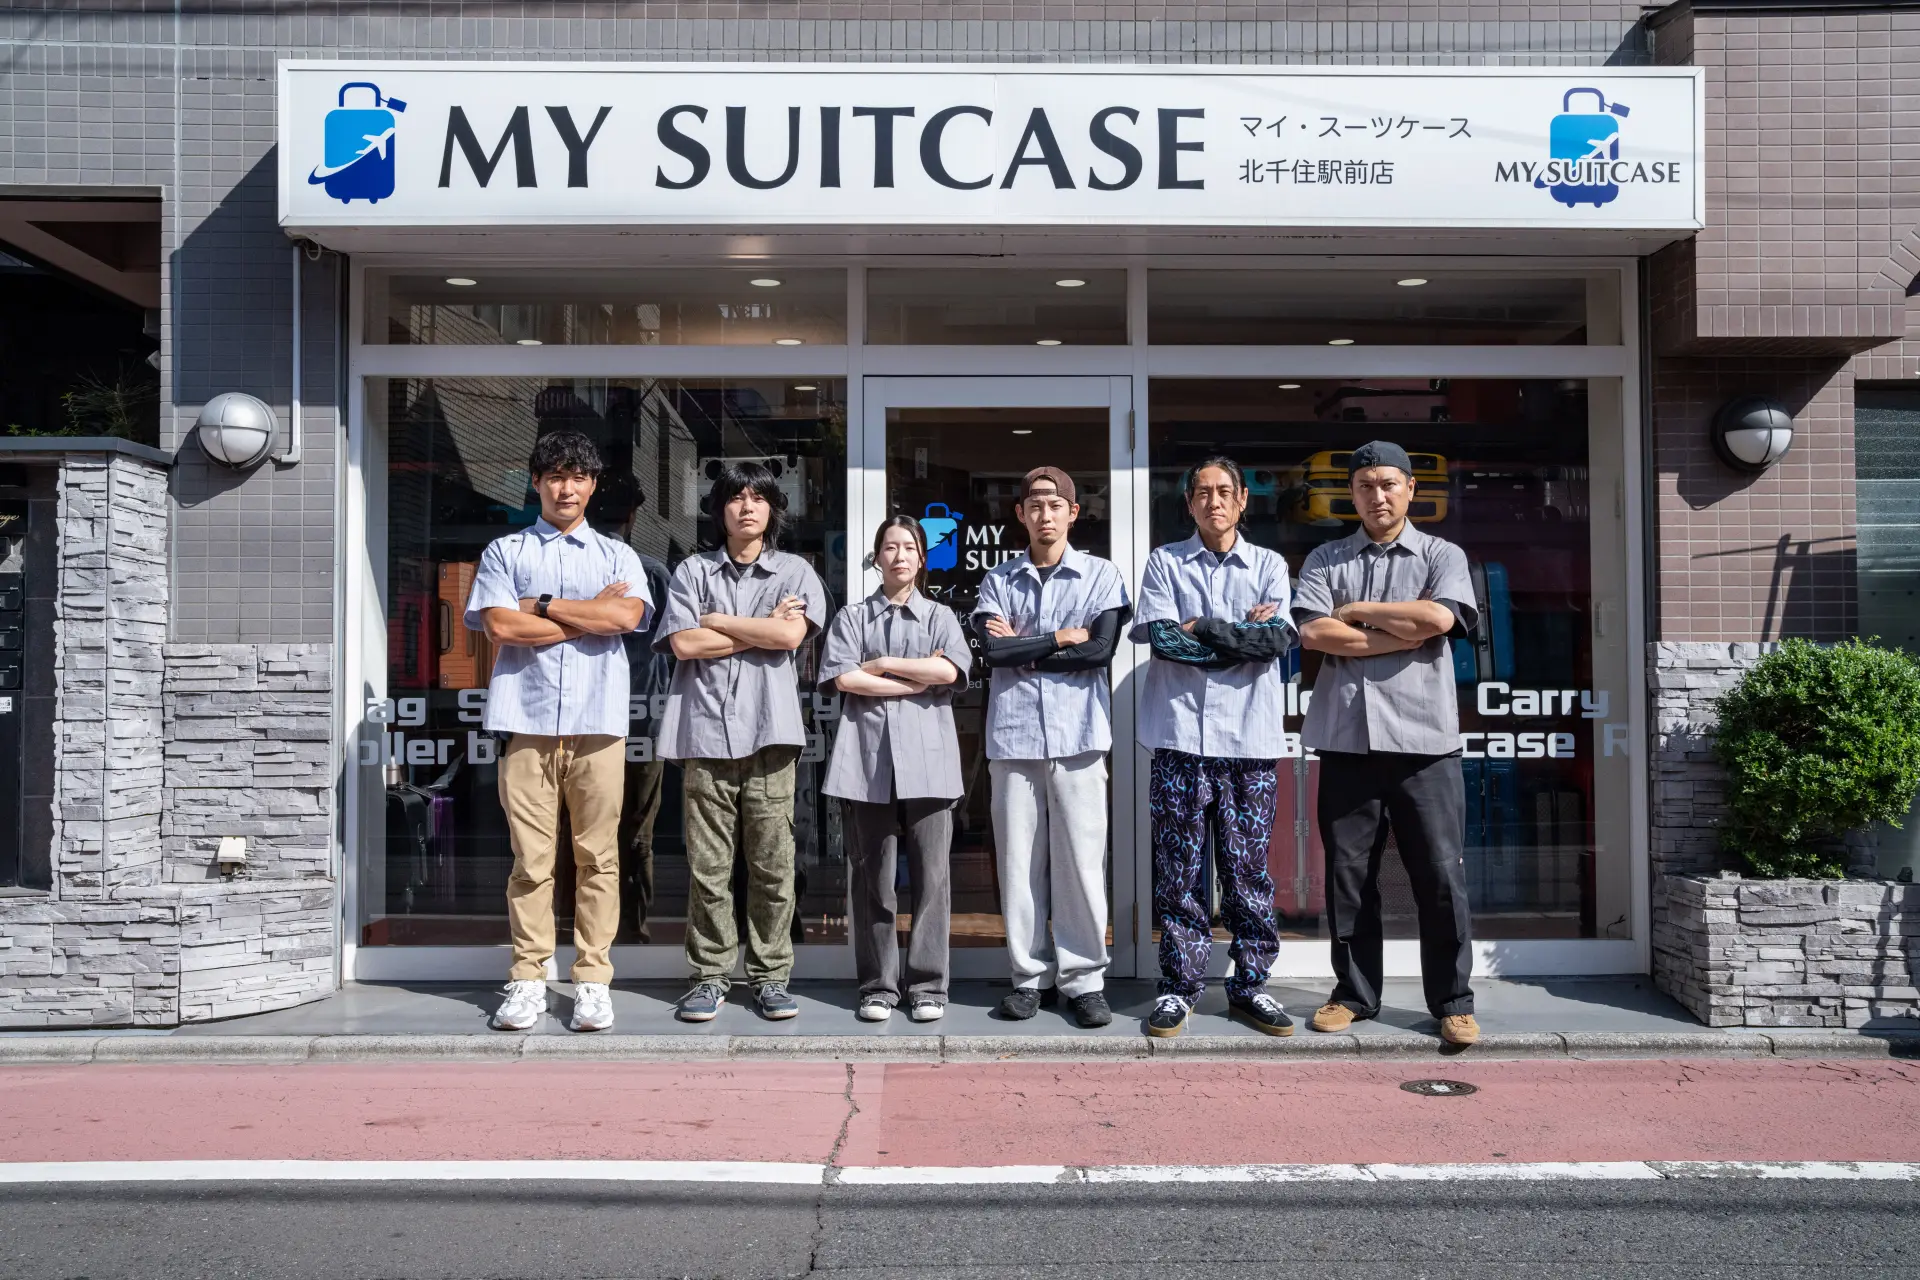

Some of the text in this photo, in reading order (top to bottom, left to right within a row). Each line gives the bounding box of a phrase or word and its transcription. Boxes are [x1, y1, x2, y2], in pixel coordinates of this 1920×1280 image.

[1239, 115, 1472, 139] マイ・スーツケース
[438, 104, 1205, 190] MY SUITCASE
[1238, 158, 1395, 185] 北千住駅前店
[1495, 161, 1681, 184] MY SUITCASE
[965, 524, 1006, 546] MY
[965, 549, 1025, 571] SUIT
[366, 697, 427, 727] ag
[1477, 681, 1610, 719] Carry
[360, 731, 456, 765] oller
[1458, 732, 1576, 759] case
